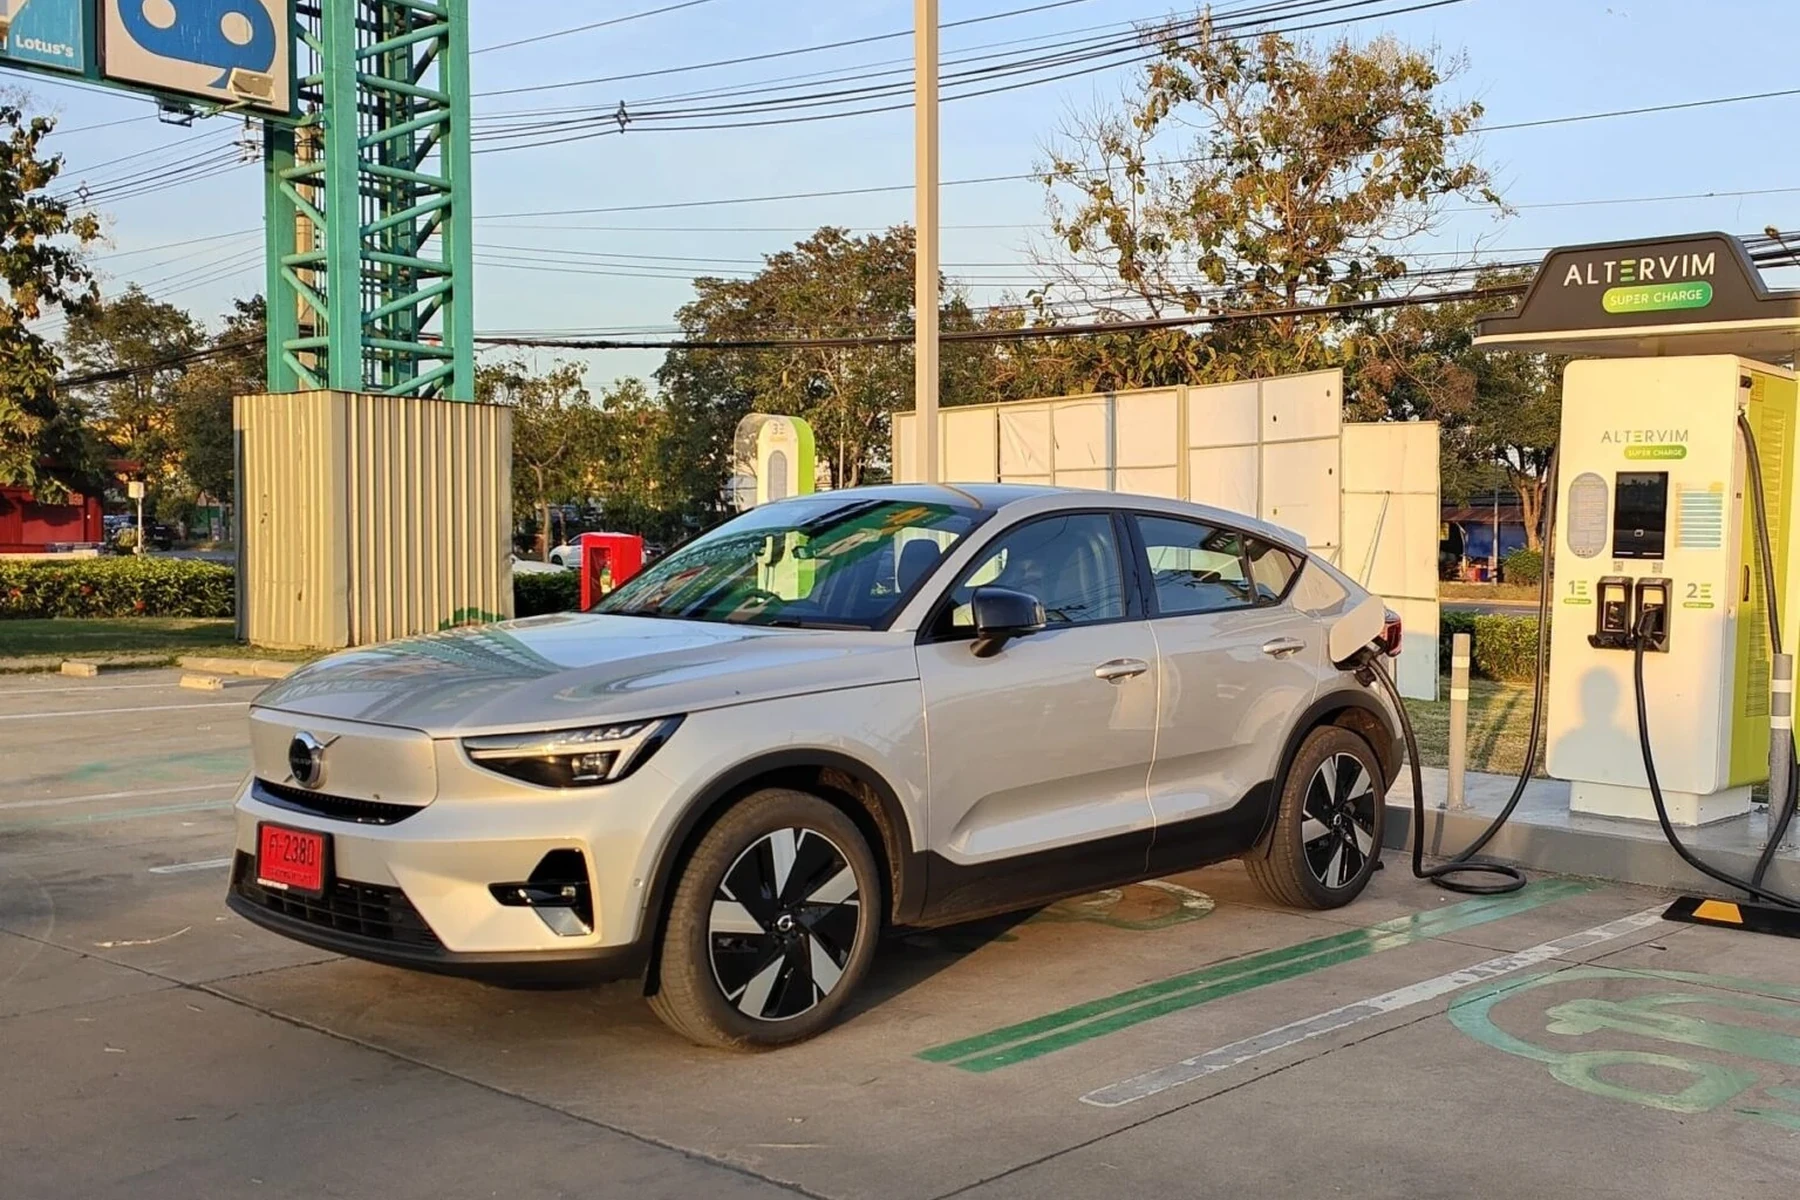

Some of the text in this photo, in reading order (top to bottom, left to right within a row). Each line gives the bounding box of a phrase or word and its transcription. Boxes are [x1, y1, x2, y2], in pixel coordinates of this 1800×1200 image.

[15, 34, 74, 58] Lotus's
[1563, 252, 1716, 286] ALTERVIM
[1610, 288, 1704, 307] SUPER CHARGE
[1601, 429, 1689, 444] ALTERVIM
